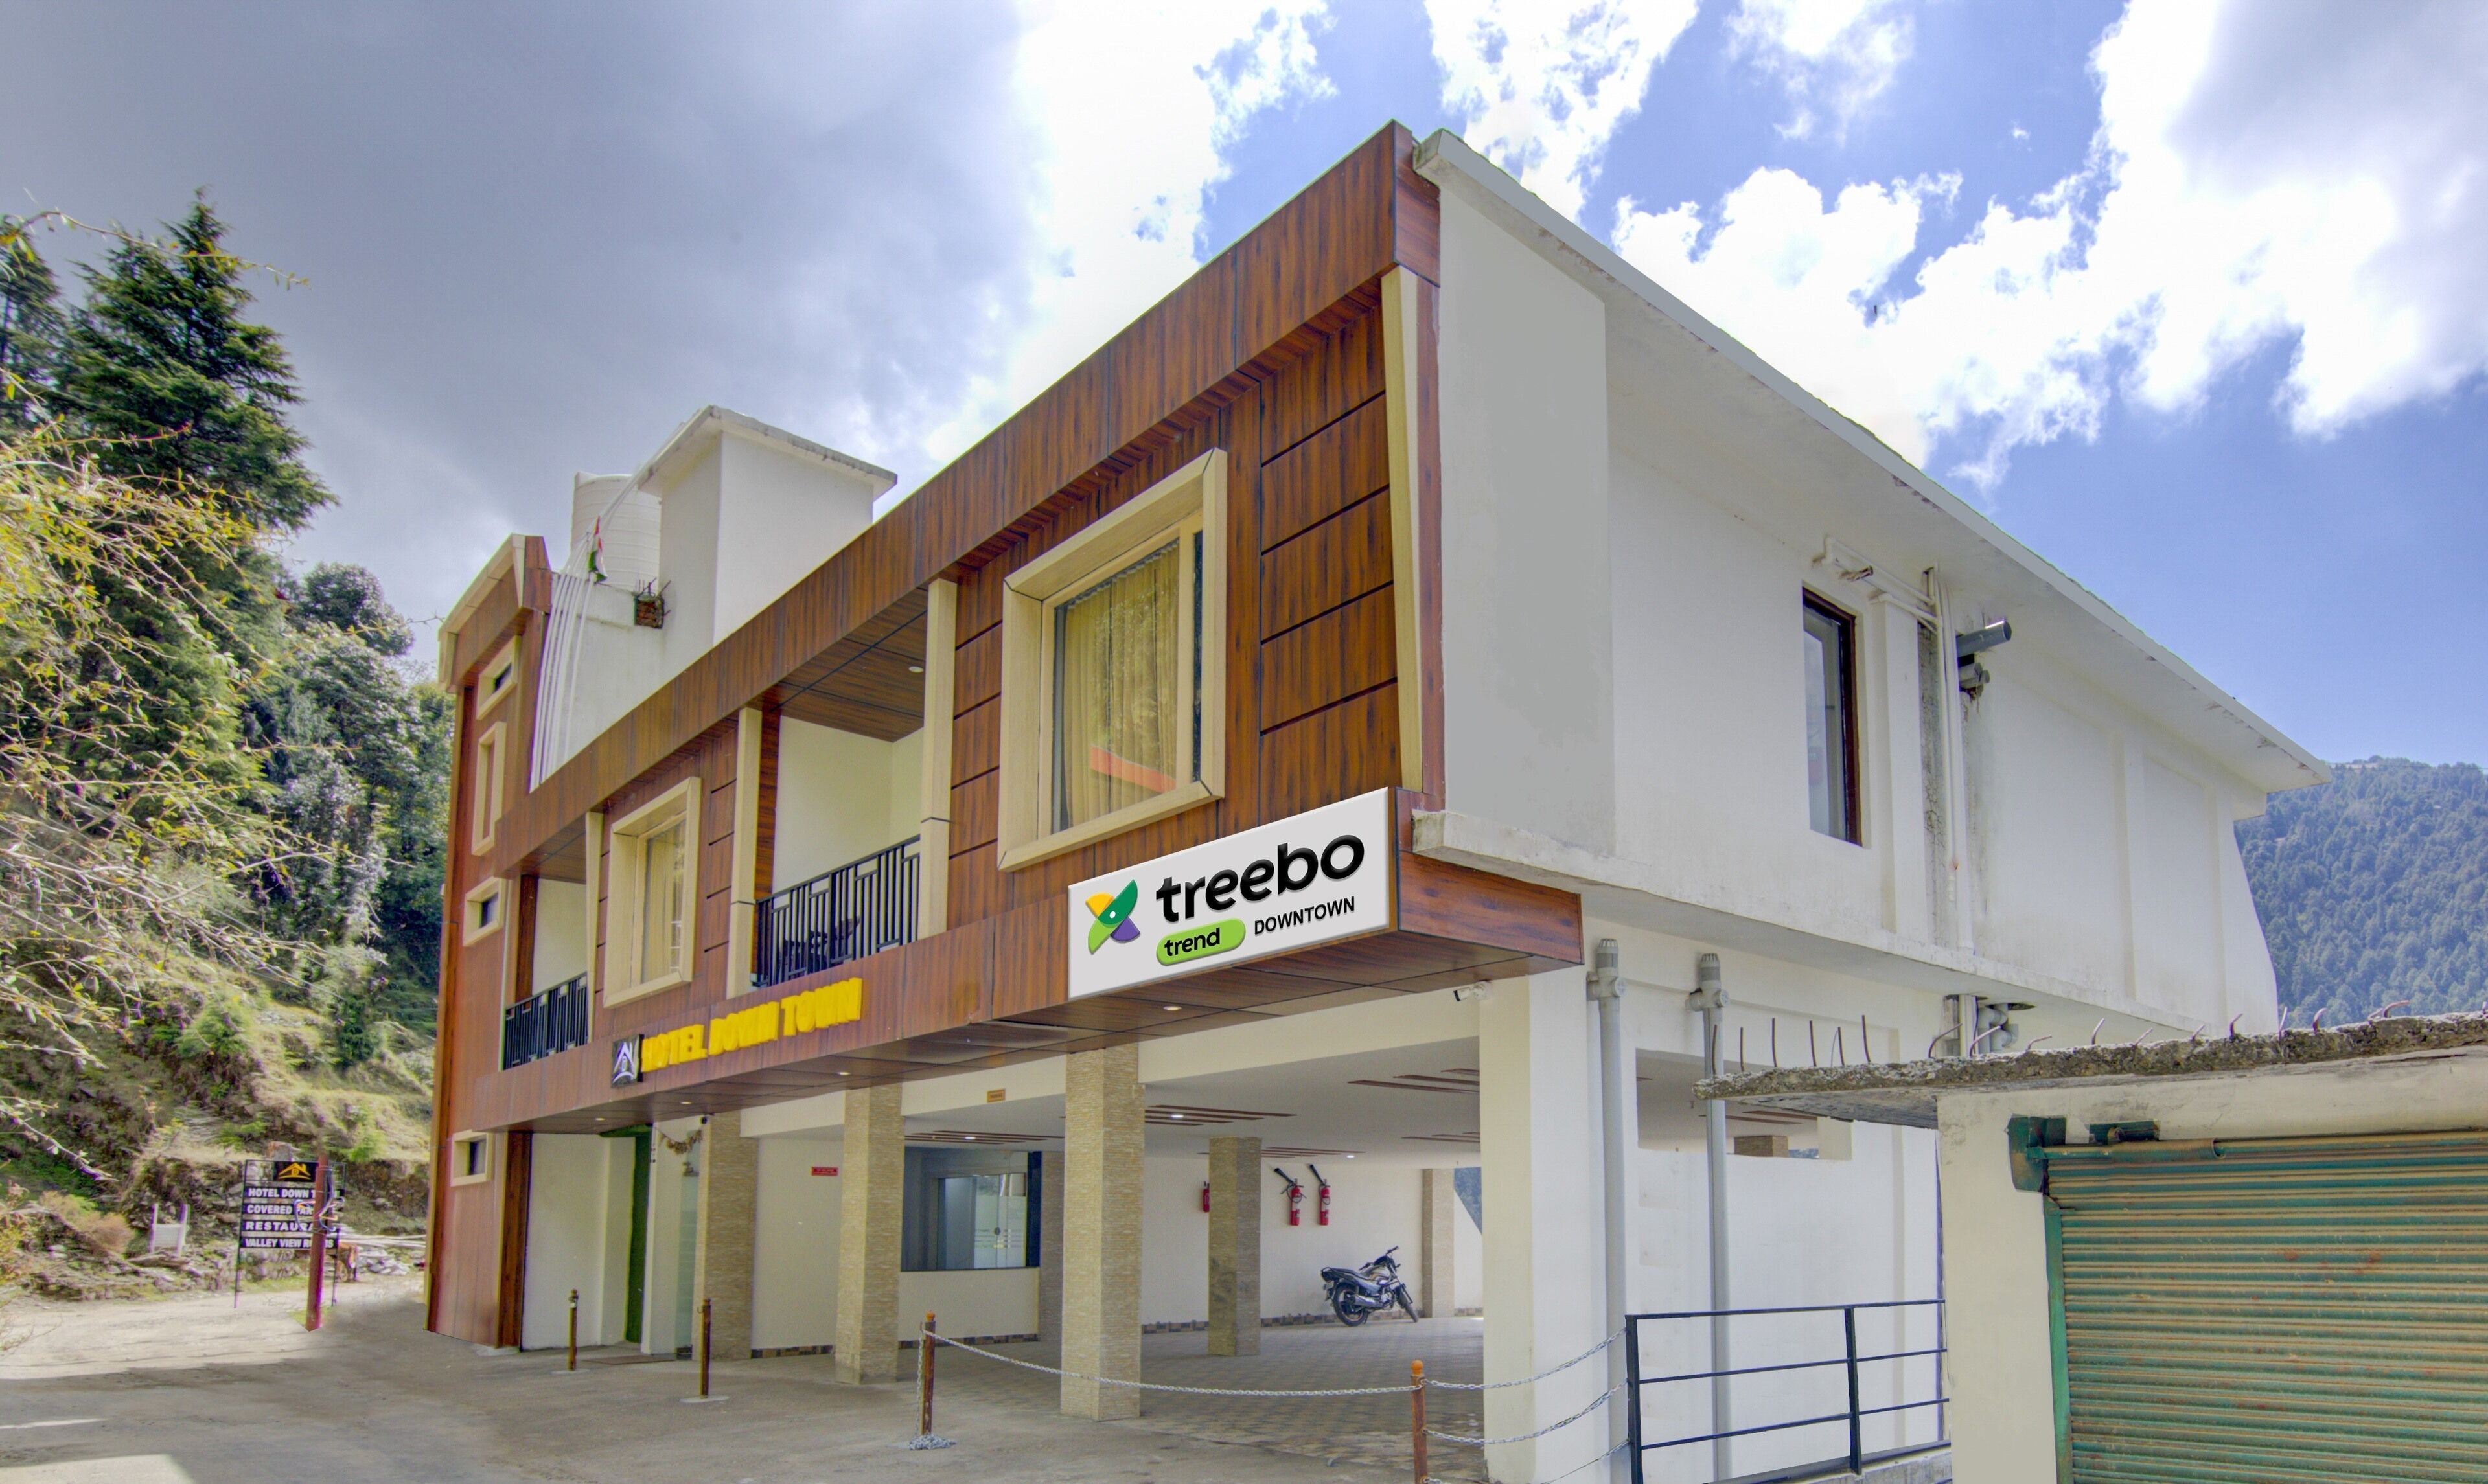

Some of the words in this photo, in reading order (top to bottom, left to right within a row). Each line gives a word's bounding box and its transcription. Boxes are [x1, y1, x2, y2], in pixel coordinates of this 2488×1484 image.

[1155, 834, 1365, 922] treebo
[1254, 896, 1355, 936] DOWNTOWN
[1164, 927, 1221, 957] trend
[641, 1024, 708, 1073] HOTEL
[709, 1001, 779, 1056] DOWN
[781, 977, 862, 1037] TOWN
[248, 1187, 279, 1197] HOTEL
[281, 1188, 309, 1198] DOWN
[247, 1204, 293, 1215] COVERED
[245, 1238, 278, 1248] VALLEY
[279, 1239, 303, 1248] VIEW
